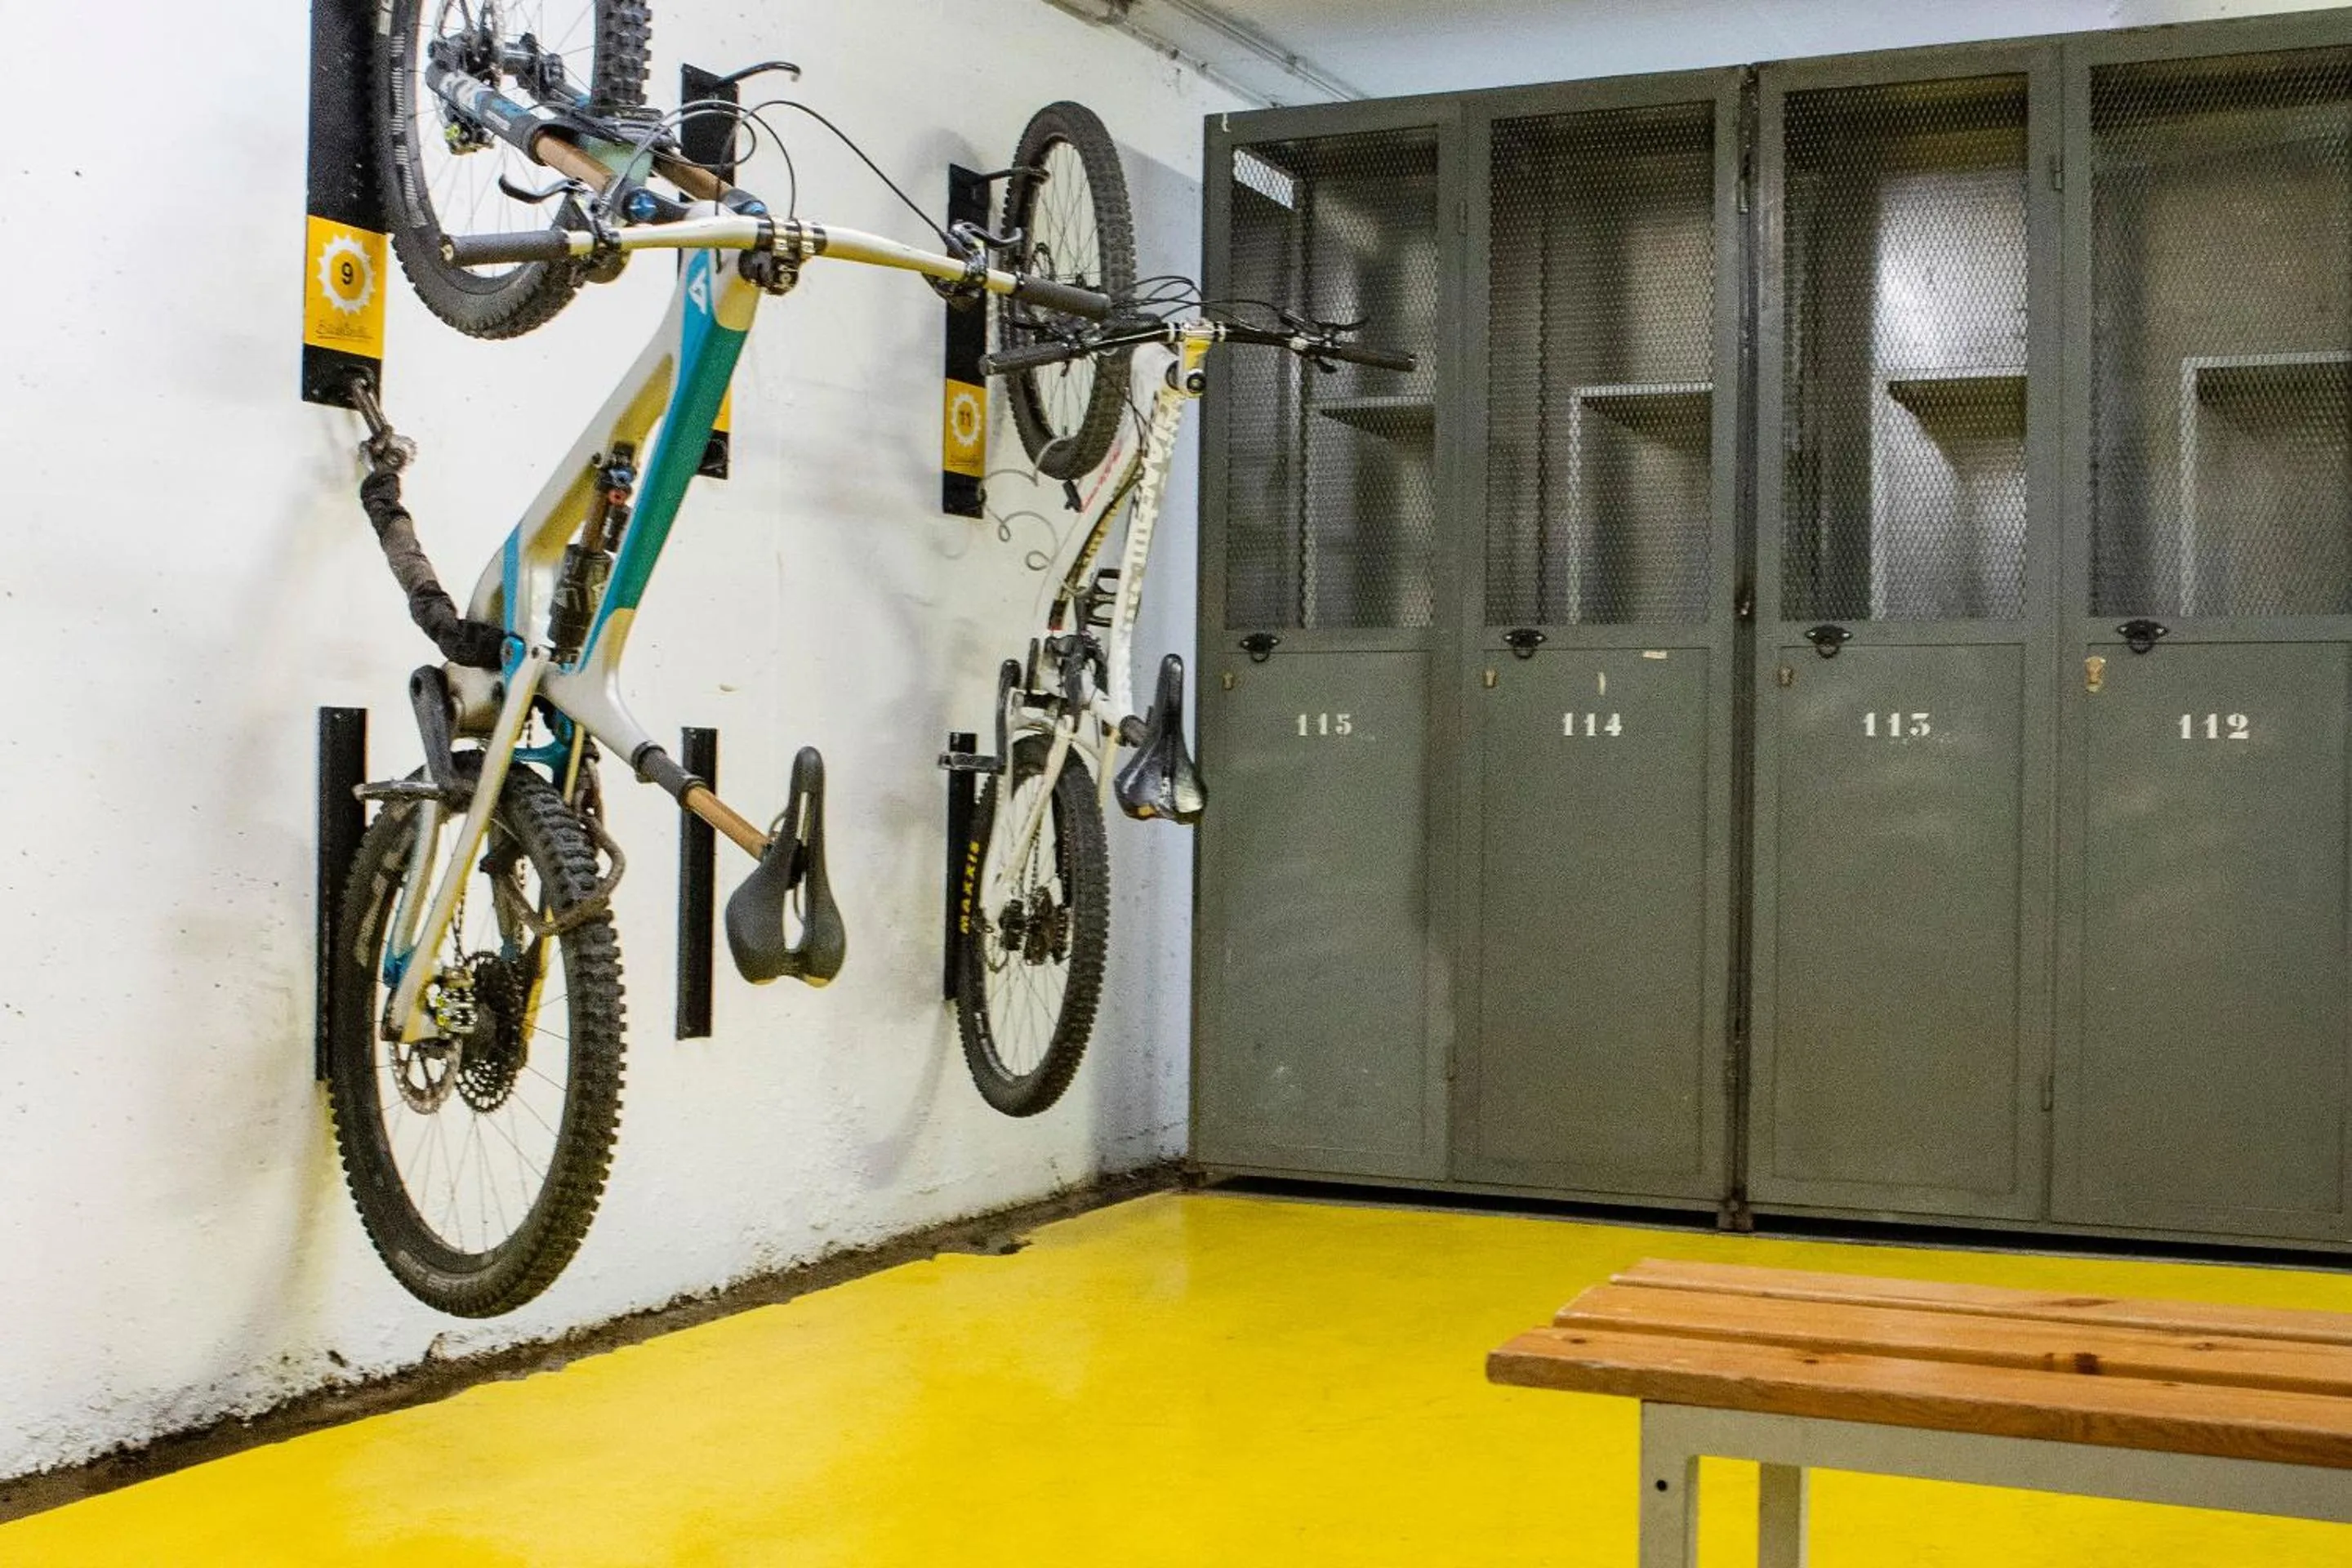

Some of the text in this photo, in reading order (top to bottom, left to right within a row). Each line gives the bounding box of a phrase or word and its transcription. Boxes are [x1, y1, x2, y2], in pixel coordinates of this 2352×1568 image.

[340, 261, 354, 286] 9
[1294, 712, 1352, 736] 115
[1561, 712, 1623, 737] 114
[1862, 711, 1931, 737] 113
[2176, 712, 2250, 739] 112
[960, 841, 980, 935] MAXXIS
